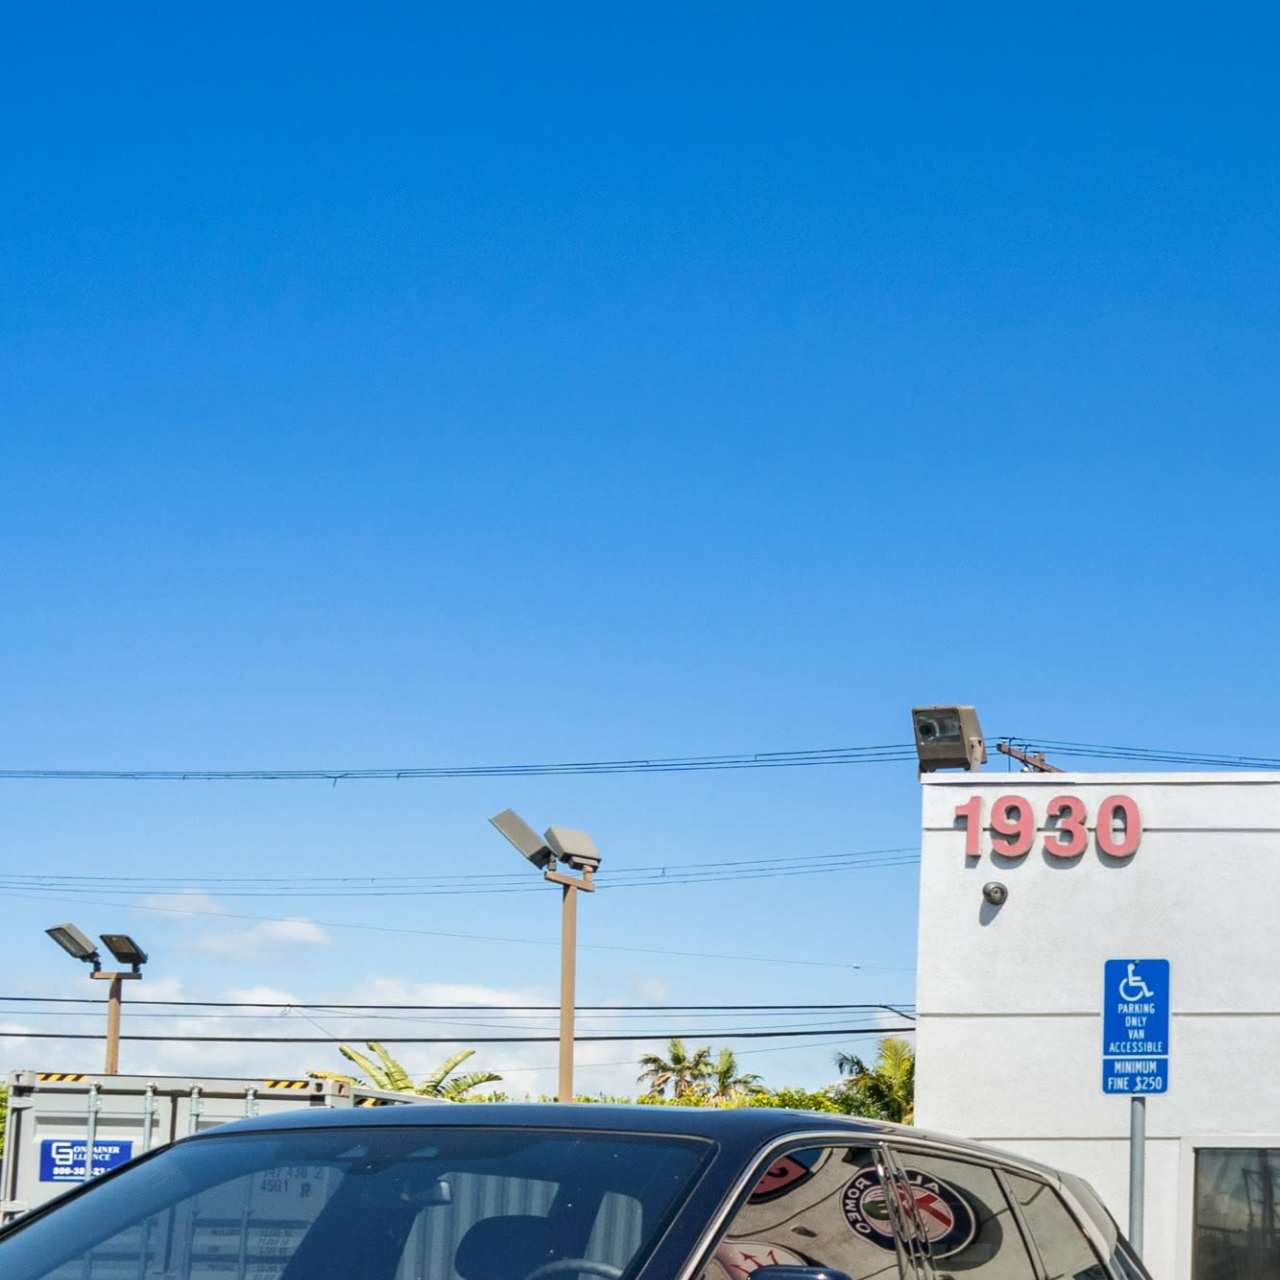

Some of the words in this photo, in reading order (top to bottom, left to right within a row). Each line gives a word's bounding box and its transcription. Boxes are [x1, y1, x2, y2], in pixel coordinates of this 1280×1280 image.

[955, 794, 1142, 857] 1930
[1118, 1003, 1156, 1015] PARKING
[1125, 1016, 1147, 1027] ONLY
[1128, 1029, 1145, 1040] VAN
[1108, 1041, 1163, 1053] ACCESSIBLE
[1114, 1060, 1157, 1074] MINIMUM
[1107, 1076, 1129, 1091] FINE
[1135, 1076, 1163, 1092] $250
